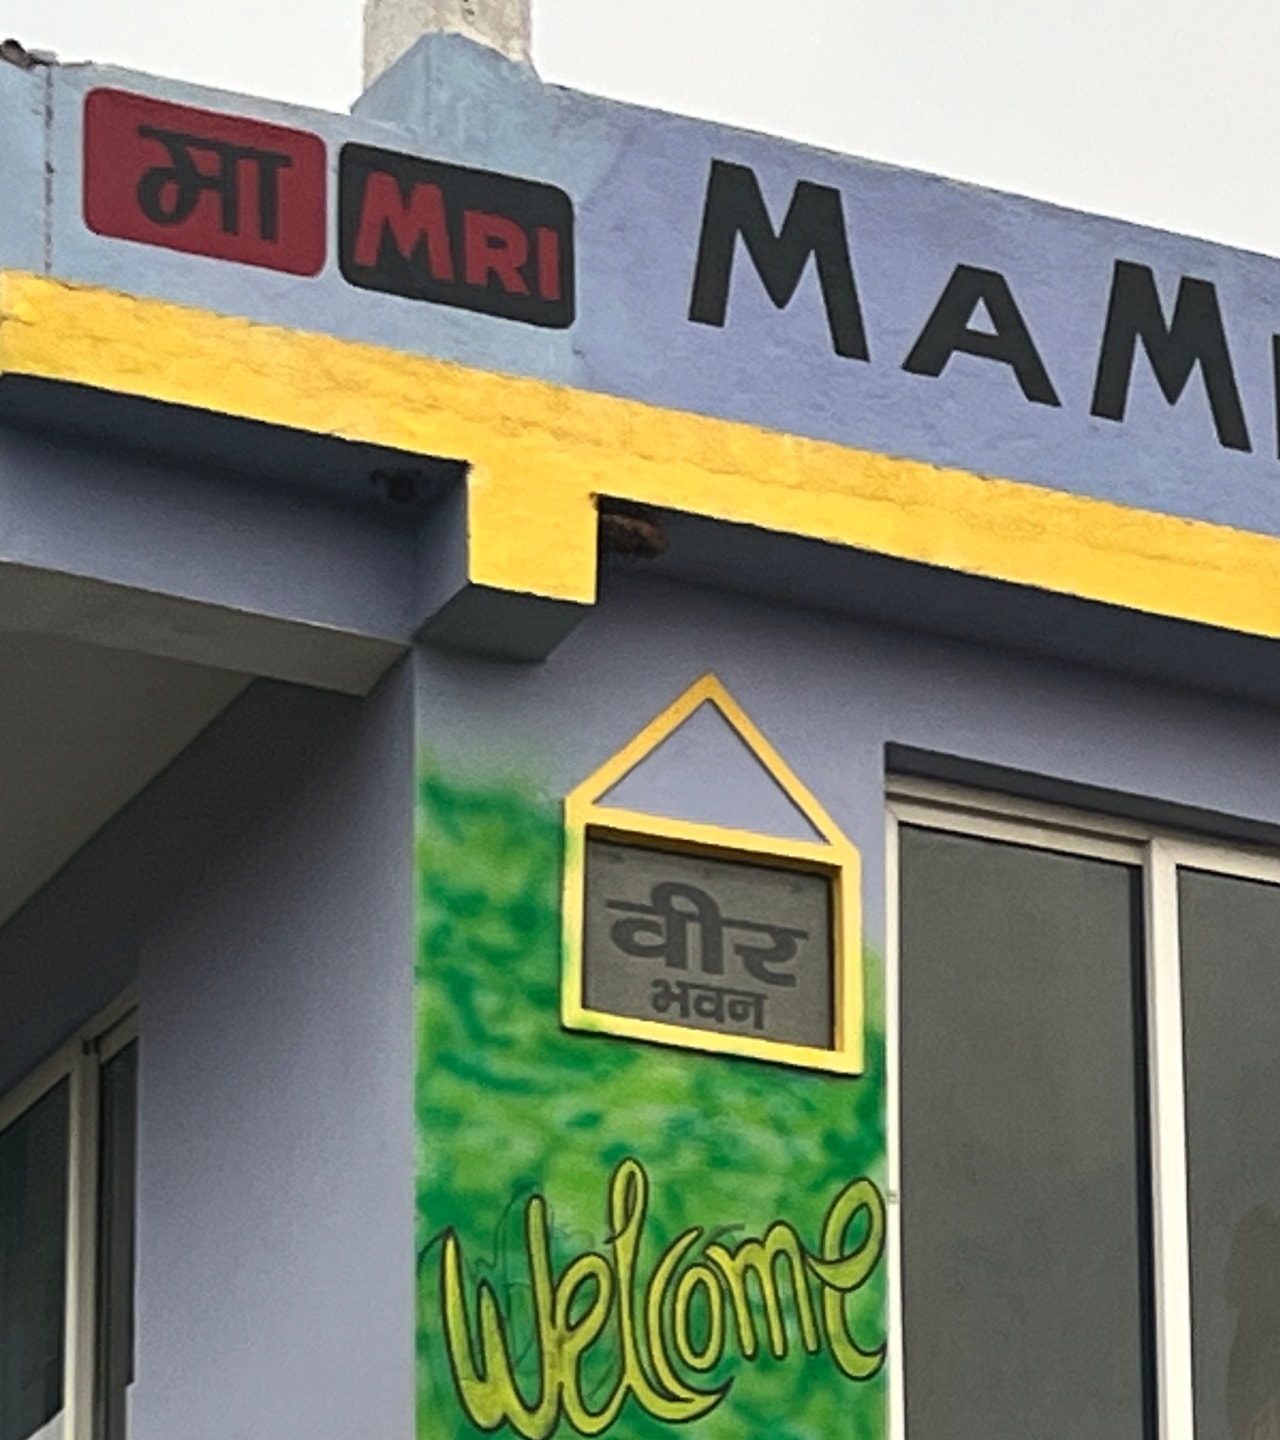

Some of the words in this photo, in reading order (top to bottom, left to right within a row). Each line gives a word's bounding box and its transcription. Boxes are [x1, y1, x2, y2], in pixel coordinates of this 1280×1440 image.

[136, 125, 293, 241] मा
[354, 170, 561, 302] MRI
[605, 880, 809, 987] वीर
[650, 978, 768, 1030] भवन
